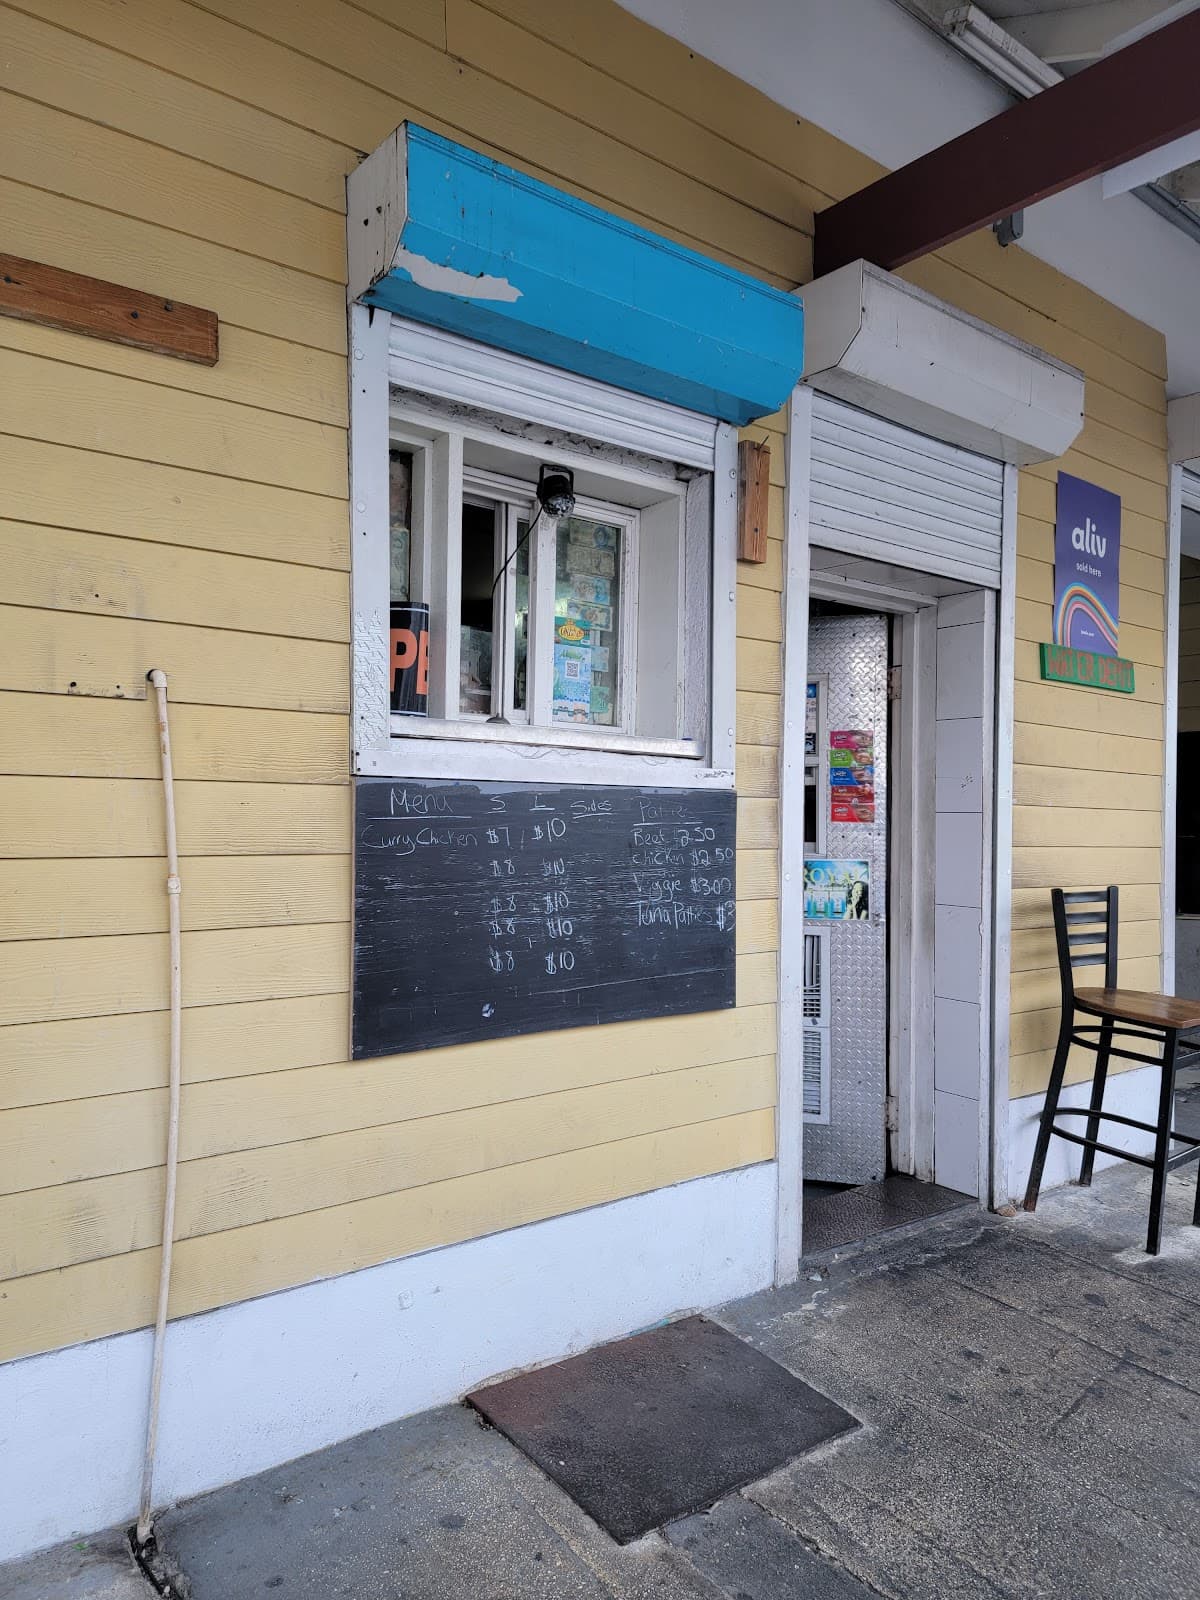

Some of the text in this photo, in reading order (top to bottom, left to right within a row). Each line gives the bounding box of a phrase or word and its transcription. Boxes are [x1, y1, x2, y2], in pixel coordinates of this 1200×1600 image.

[1072, 518, 1106, 558] aliv
[1076, 562, 1101, 578] sold here
[390, 787, 454, 815] Menu
[570, 799, 613, 813] Sides
[360, 817, 566, 856] Curry Chicken $7 $10
[543, 890, 569, 915] $10
[546, 918, 573, 939] $10
[545, 951, 575, 975] $10
